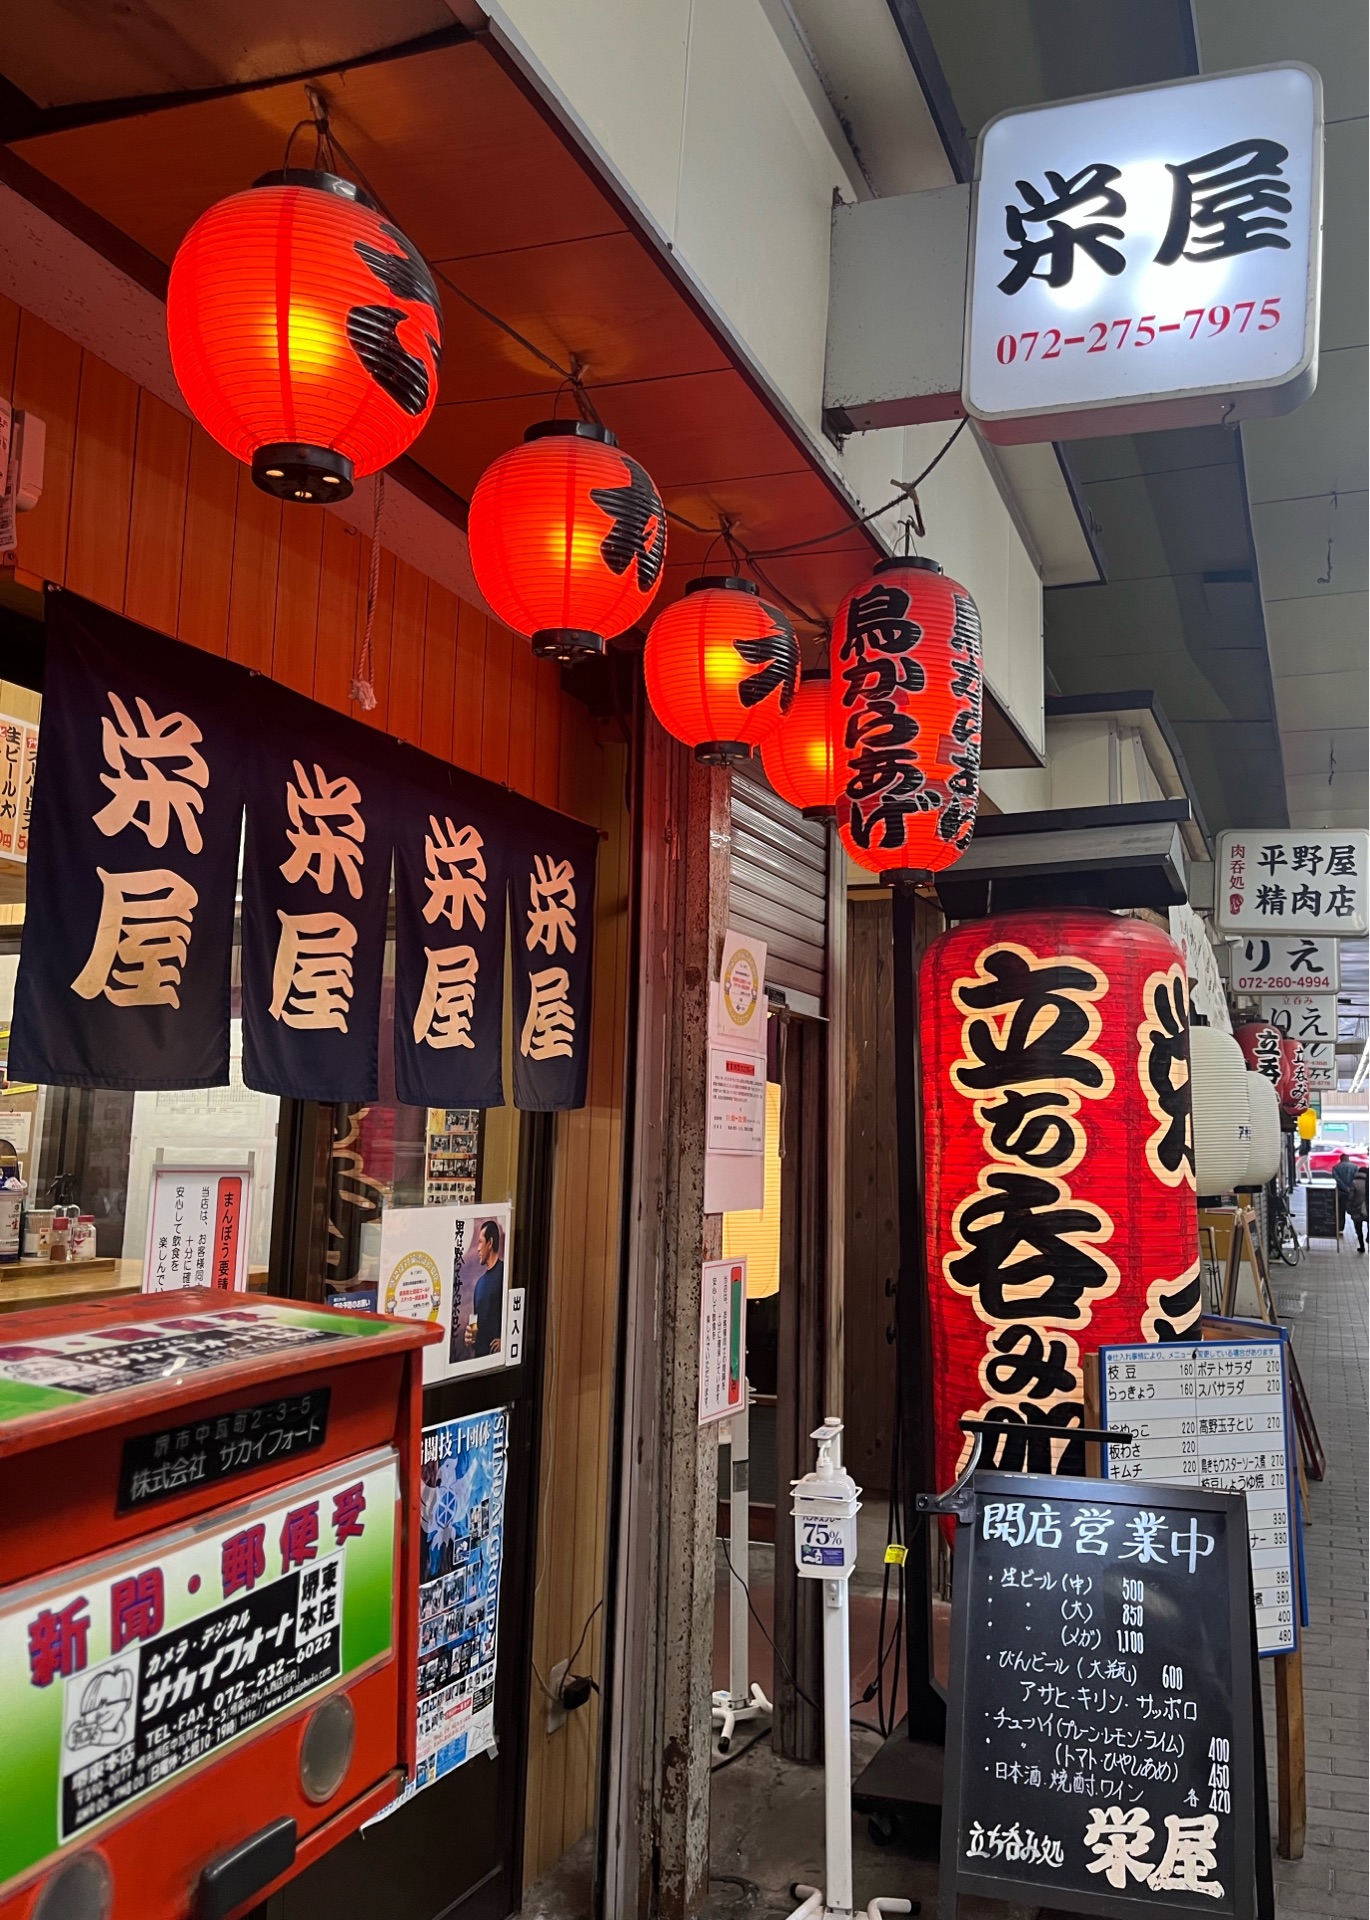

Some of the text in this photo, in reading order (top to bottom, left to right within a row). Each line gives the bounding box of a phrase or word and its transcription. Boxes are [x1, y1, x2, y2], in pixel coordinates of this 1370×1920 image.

[997, 138, 1292, 295] 栄屋
[996, 297, 1281, 365] 072-275-7975
[840, 584, 941, 849] 鳥からあげ
[70, 691, 209, 1009] 栄屋
[1257, 844, 1358, 877] 平野屋
[1229, 844, 1245, 890] 肉呑処
[268, 760, 365, 1033] 栄屋
[1255, 884, 1357, 917] 精肉店
[413, 814, 486, 1049] 栄屋
[520, 855, 576, 1060] 栄屋
[1245, 939, 1325, 973] りえ
[1239, 976, 1330, 989] 072-260-4994
[171, 1186, 185, 1272] 安心して飲食を
[195, 1186, 210, 1284] 当店は、お客様同
[182, 1236, 194, 1288] 十分に確
[510, 1296, 522, 1358] 出入口
[1180, 1364, 1193, 1376] 160
[1198, 1360, 1280, 1377] ポテトサラダ 270
[1108, 1384, 1194, 1400] らっきょう 160
[1267, 1380, 1281, 1392] 270
[1182, 1422, 1195, 1434] 220
[1199, 1417, 1281, 1434] 高野玉子とじ 270
[131, 1413, 320, 1500] 株式会社 サカイフォート
[1109, 1441, 1196, 1460] 板わさ 220
[1271, 1455, 1285, 1467] 270
[1110, 1461, 1197, 1480] キムチ 220
[1271, 1474, 1285, 1486] 270
[484, 1415, 505, 1631] SHINDAI GROUP
[803, 1522, 842, 1546] 75%
[1273, 1513, 1287, 1525] 330
[982, 1503, 1215, 1573] 開店営業中
[1274, 1532, 1288, 1545] 330
[28, 1482, 366, 1687] 新聞・郵便受
[1122, 1577, 1144, 1602] 500
[1061, 1599, 1144, 1627] (大) 850
[1278, 1610, 1291, 1623] 400
[145, 1608, 250, 1678] カメラ・デジタル
[1061, 1625, 1102, 1650] (メガ)
[1279, 1629, 1292, 1642] 480
[141, 1612, 294, 1722] サカイフォート
[212, 1632, 332, 1712] 072-232-6022
[1162, 1665, 1184, 1691] 600
[1208, 1737, 1230, 1763] 400
[1208, 1765, 1230, 1790] 450
[1183, 1788, 1200, 1808] 各
[1209, 1789, 1231, 1815] 420
[966, 1820, 1065, 1868] 立ち呑み処
[1084, 1805, 1226, 1899] 栄屋
